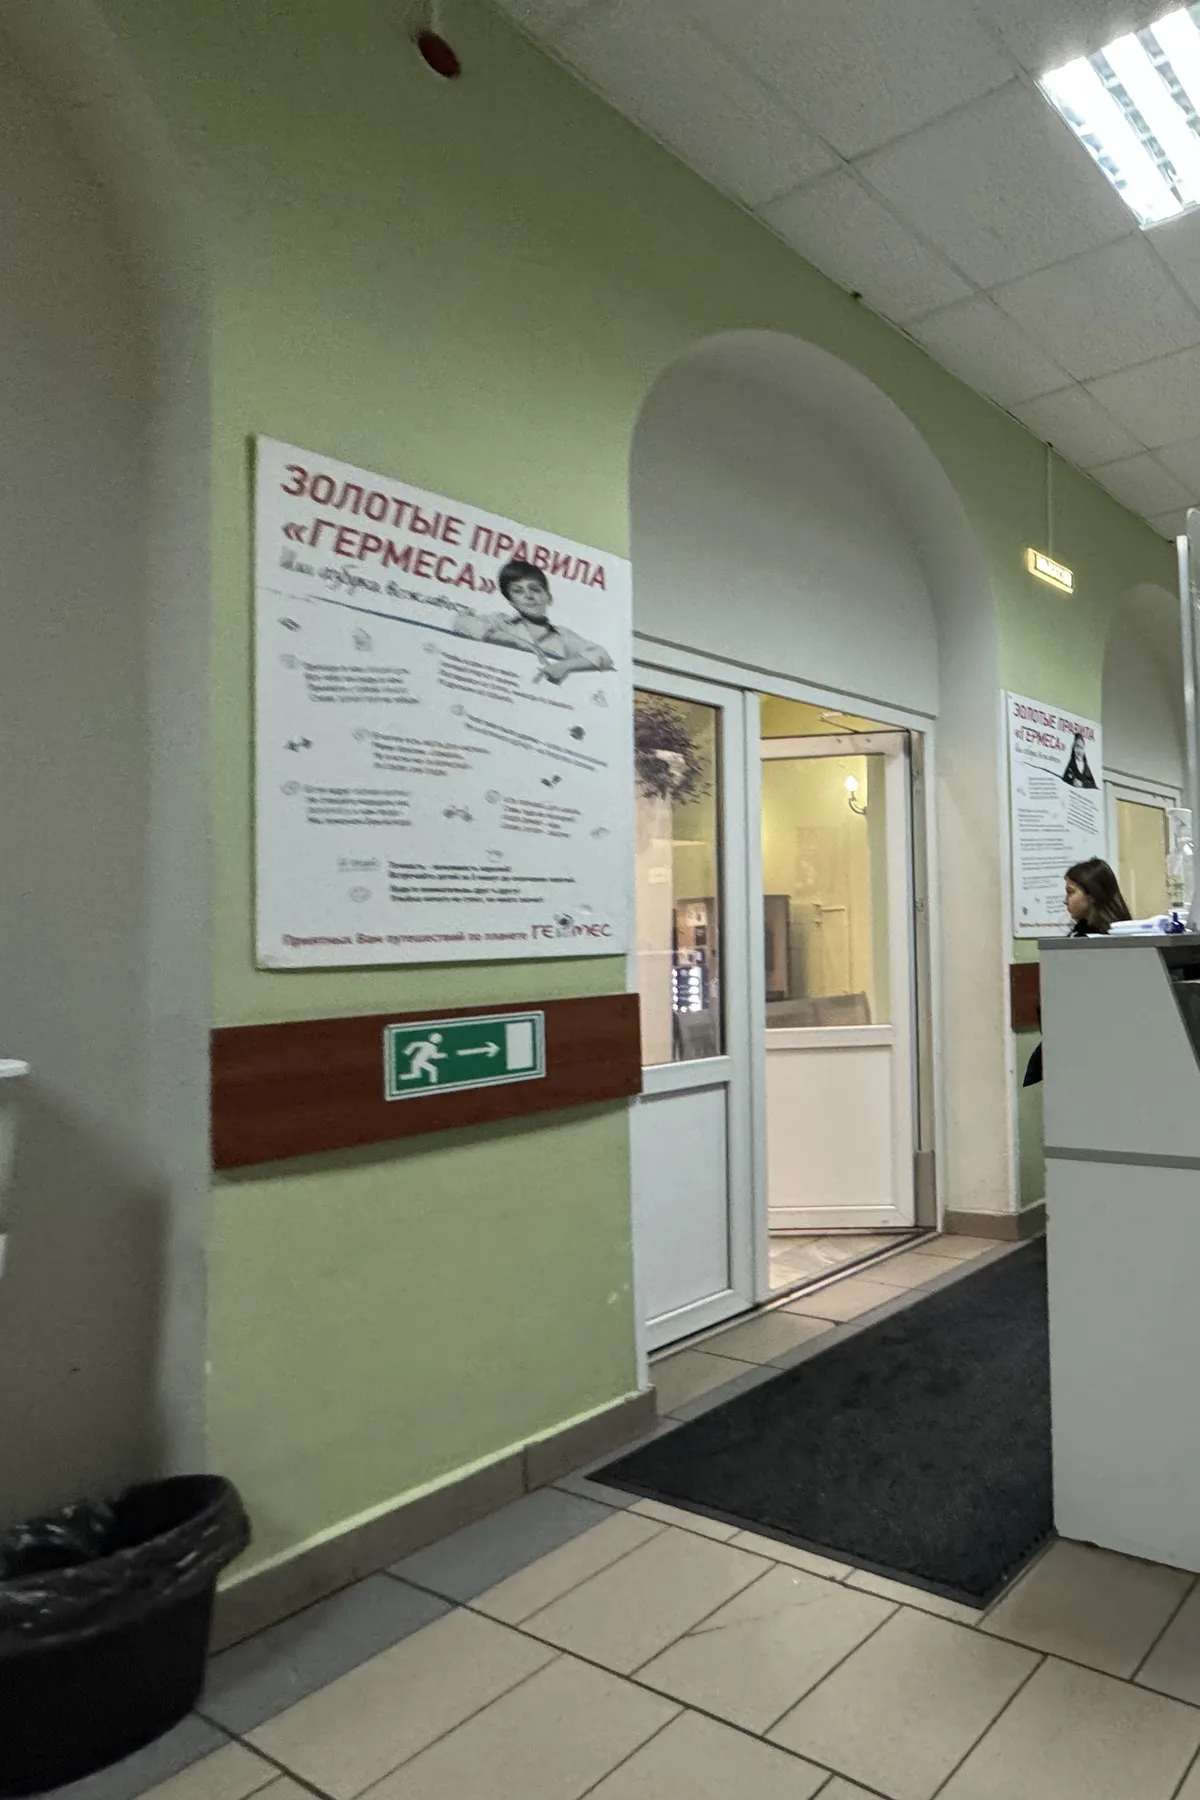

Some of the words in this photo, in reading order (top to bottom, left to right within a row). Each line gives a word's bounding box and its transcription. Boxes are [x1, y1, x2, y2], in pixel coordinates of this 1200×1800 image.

[280, 464, 465, 547] ЗОЛОТЫЕ
[469, 524, 607, 592] ПРАВИЛА
[281, 518, 496, 595] «ГЕРМЕСА»
[1013, 702, 1057, 730] ЗОЛОТЫЕ
[1057, 717, 1095, 742] ПРАВИЛА
[531, 923, 613, 940] ГЕМЕС
